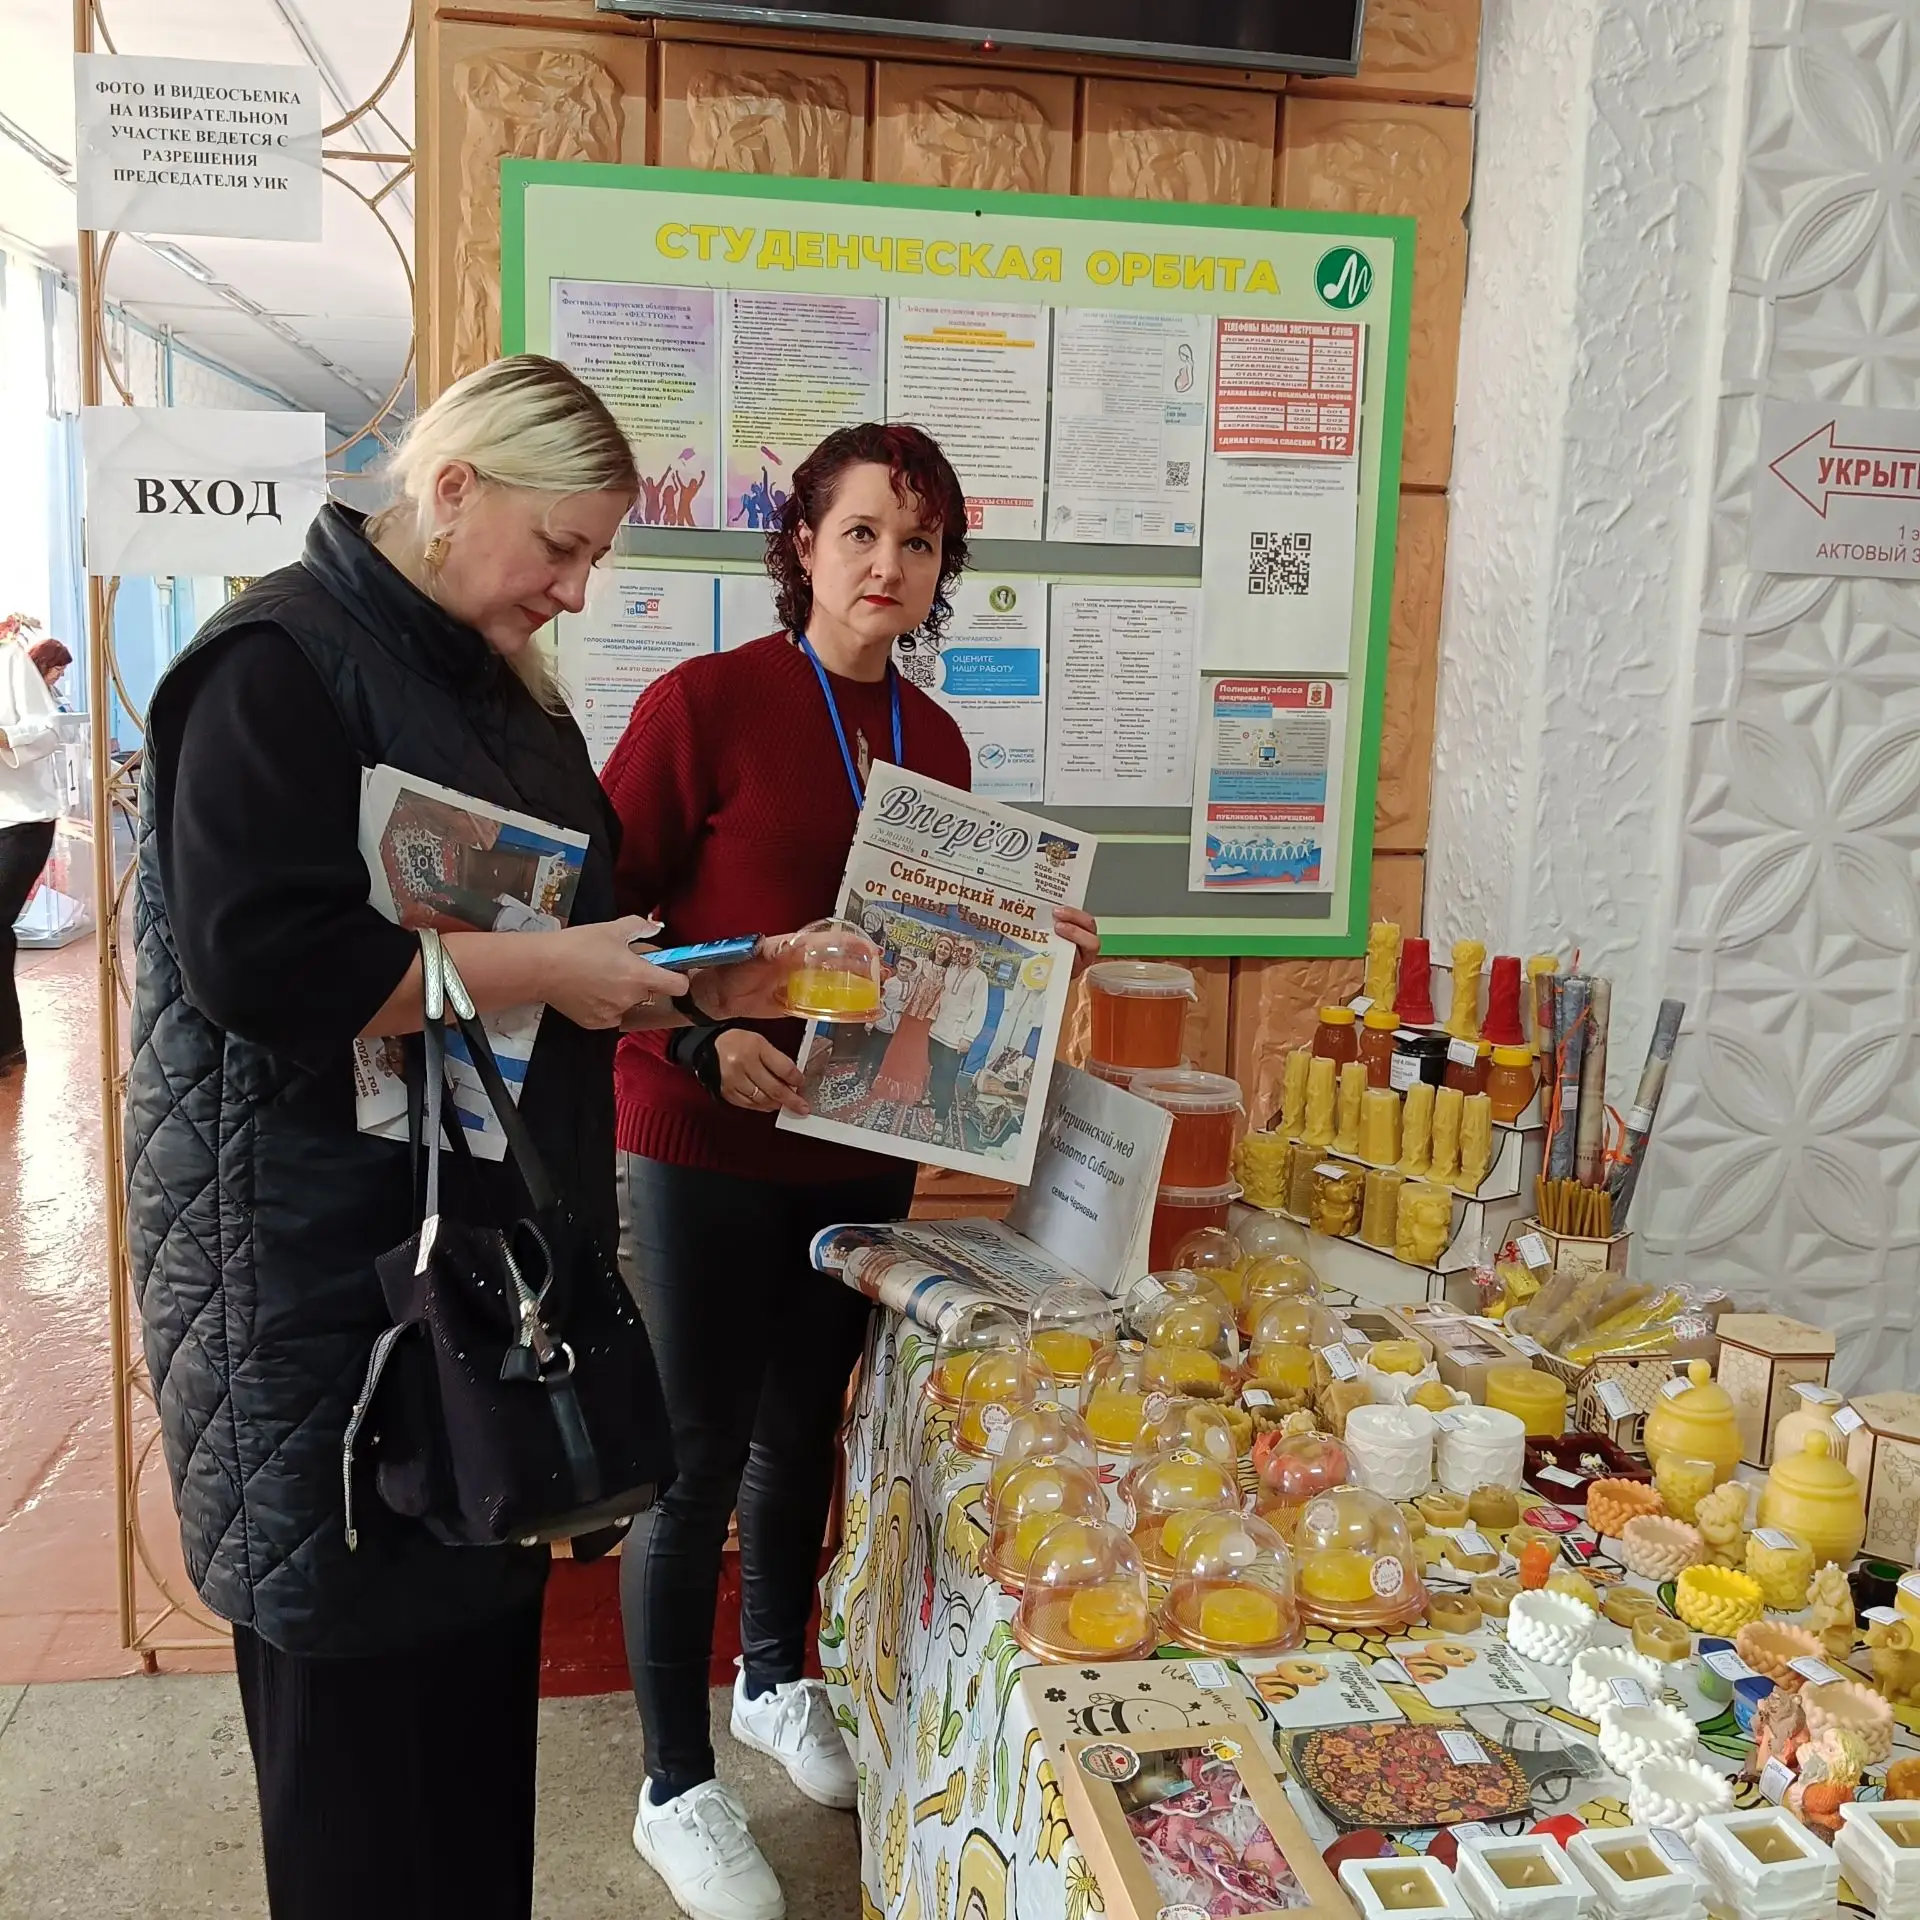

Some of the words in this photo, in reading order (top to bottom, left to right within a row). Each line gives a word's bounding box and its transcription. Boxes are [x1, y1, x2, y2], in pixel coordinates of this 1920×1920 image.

[96, 81, 144, 95] ФОТО
[155, 84, 165, 96] И
[171, 84, 301, 105] ВИДЕОСЪЕМКА
[110, 104, 133, 116] НА
[139, 105, 288, 125] ИЗБИРАТЕЛЬНОМ
[111, 126, 191, 142] УЧАСТКЕ
[196, 131, 272, 146] ВЕДЕТСЯ
[277, 135, 288, 147] С
[143, 149, 257, 166] РАЗРЕШЕНИЯ
[114, 169, 247, 188] ПРЕДСЕДАТЕЛЯ
[253, 176, 288, 190] УИК
[655, 222, 1062, 283] СТУДЕНЧЕСКАЯ
[1085, 250, 1281, 295] ОРБИТА
[1224, 322, 1259, 332] ТЕЛЕФОНЫ
[1319, 436, 1347, 450] 112
[1818, 457, 1920, 490] УКРЫТ
[134, 478, 282, 525] ВХОД
[1899, 525, 1905, 540] 1
[1816, 543, 1907, 562] АКТОВЫЙ
[647, 601, 658, 609] 20
[952, 655, 994, 664] ОЦЕНИТЕ
[952, 665, 978, 673] НАШУ
[1219, 685, 1259, 693] Полиция
[1261, 686, 1303, 694] Кузбасса
[1034, 862, 1053, 874] 2026
[1034, 870, 1069, 887] единства
[890, 860, 995, 906] Сибирский
[998, 896, 1037, 921] мёд
[1036, 885, 1063, 898] России
[865, 879, 886, 897] от
[892, 888, 948, 917] семьи
[956, 904, 1049, 944] Черновых
[355, 1039, 371, 1067] 2026
[368, 1076, 380, 1096] год
[1055, 1104, 1114, 1149] Мариинский
[1114, 1141, 1135, 1159] мед
[1050, 1136, 1086, 1166] «Золото
[1087, 1155, 1125, 1187] Сибири»
[1051, 1185, 1069, 1203] семьи
[1070, 1195, 1098, 1222] Черновых
[1337, 1669, 1379, 1713] Хорошего
